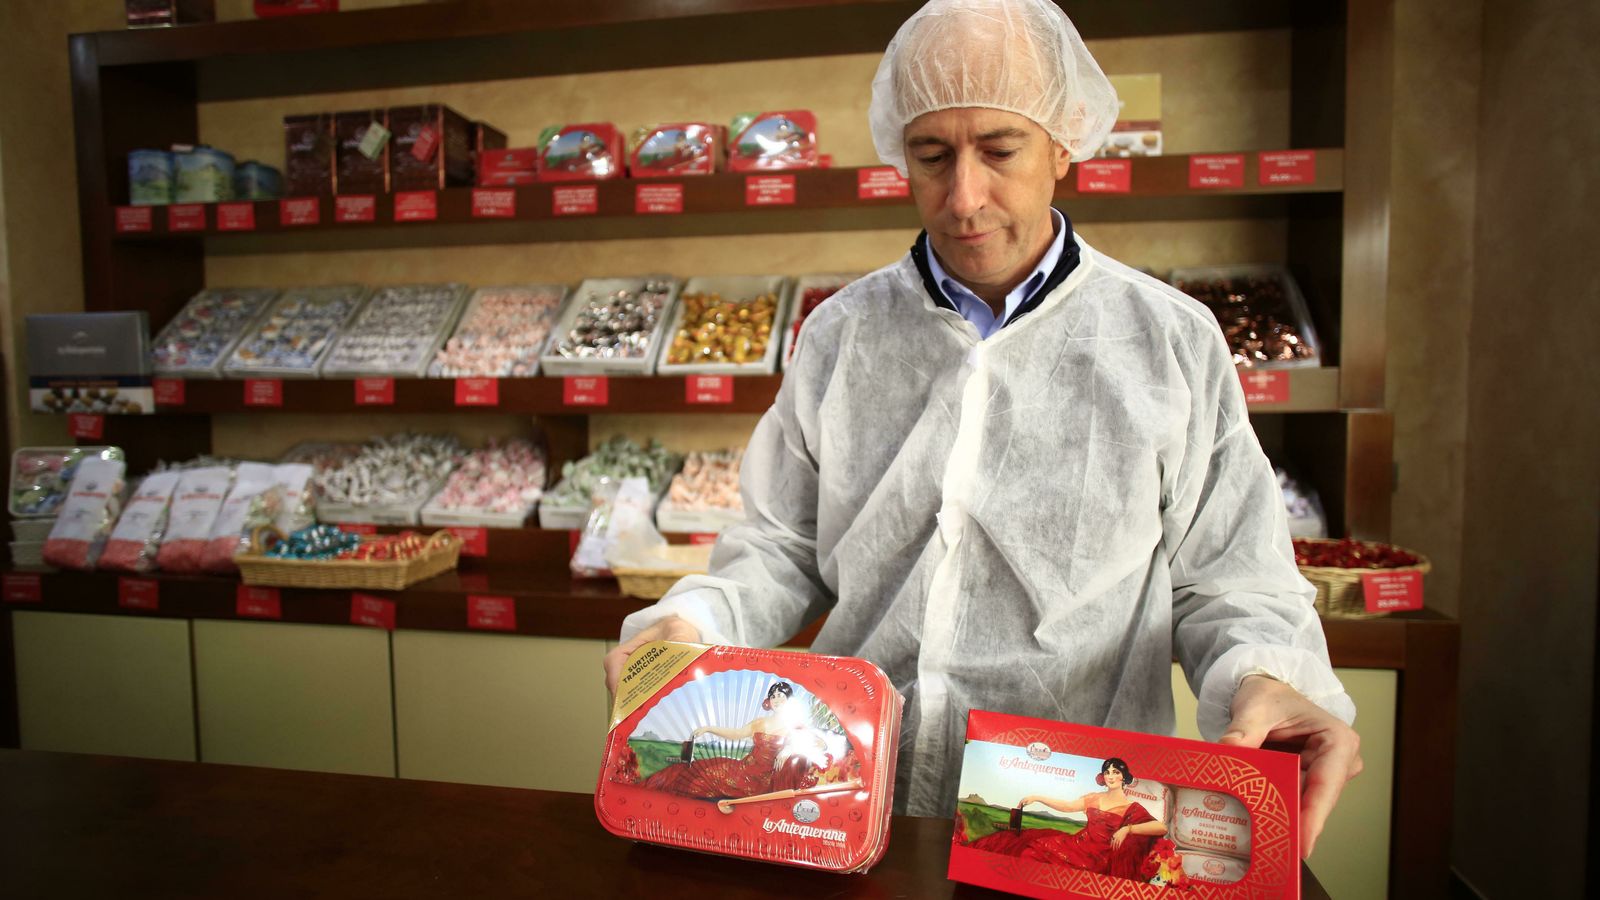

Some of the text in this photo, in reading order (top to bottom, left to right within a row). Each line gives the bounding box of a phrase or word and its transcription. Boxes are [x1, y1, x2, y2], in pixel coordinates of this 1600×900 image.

[622, 646, 668, 683] TRADICIONAL
[628, 647, 657, 672] SURTIDO
[1007, 756, 1076, 777] Antequerana
[1187, 807, 1248, 826] Antequerana
[771, 819, 847, 842] Antequerana
[1191, 829, 1237, 842] HOJALDRE
[1190, 837, 1238, 850] ARTESANO
